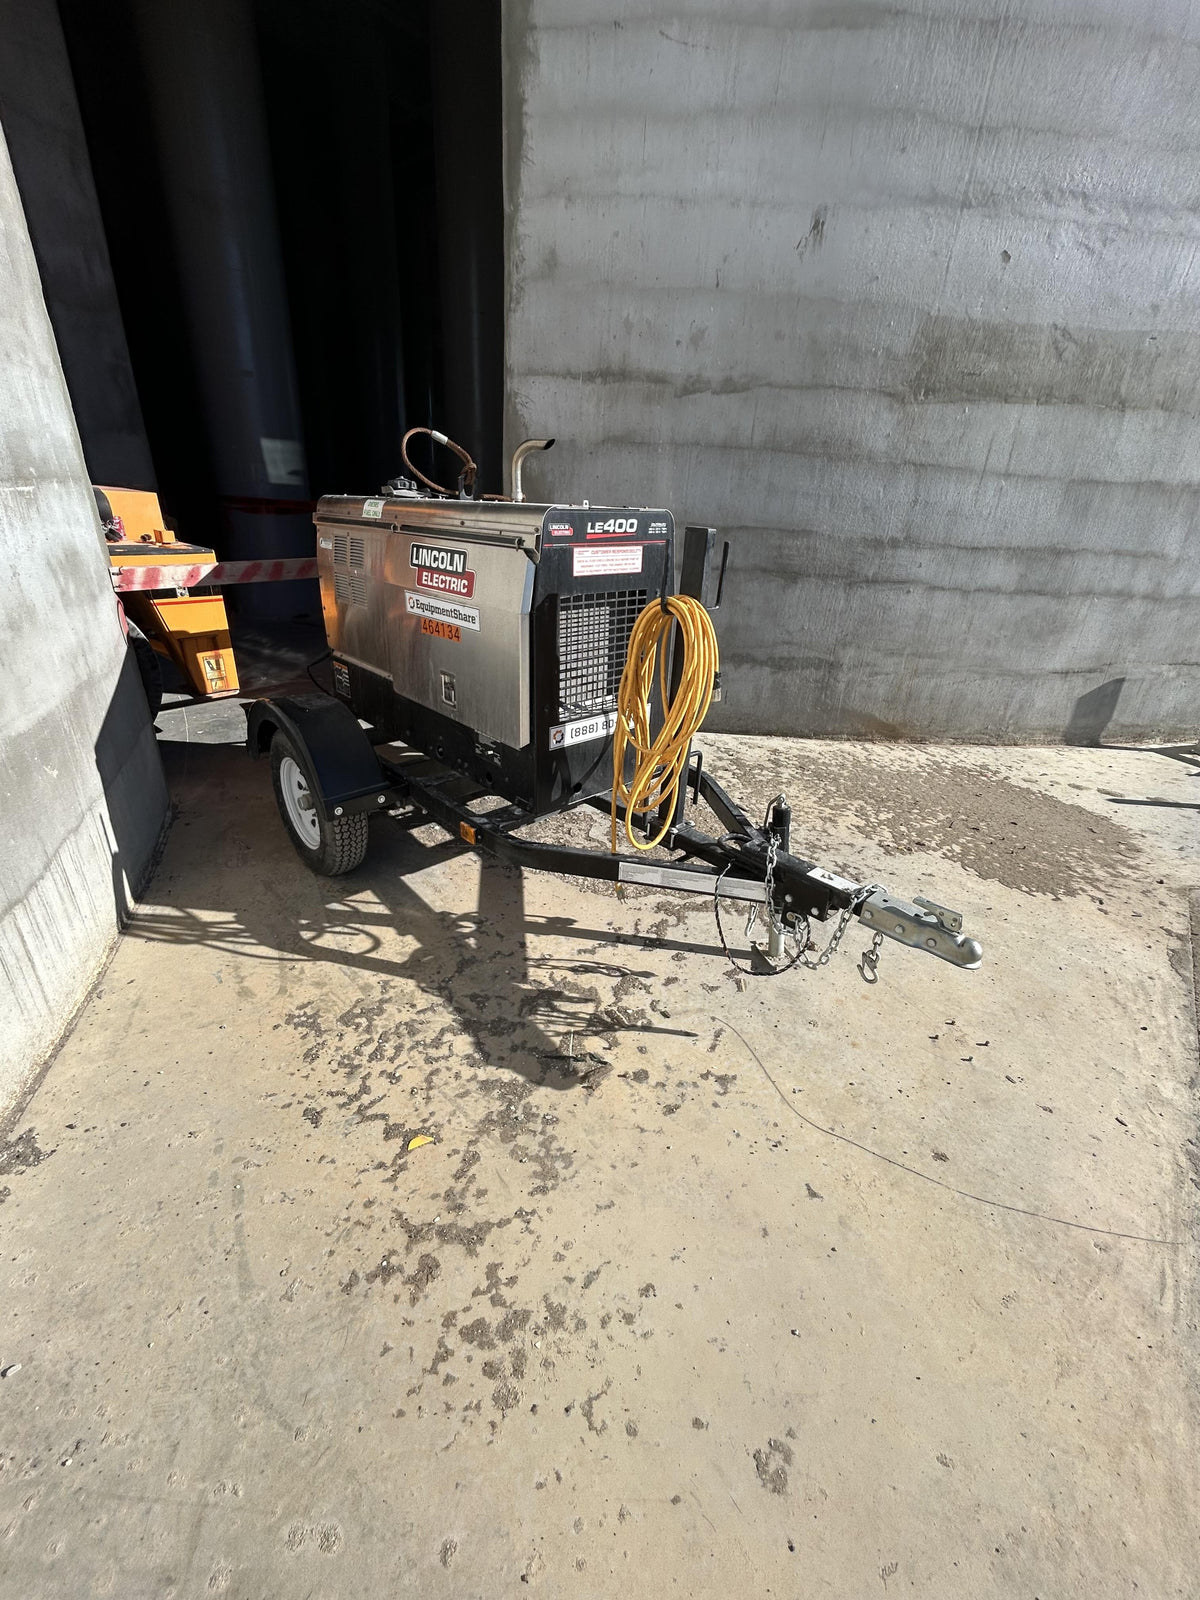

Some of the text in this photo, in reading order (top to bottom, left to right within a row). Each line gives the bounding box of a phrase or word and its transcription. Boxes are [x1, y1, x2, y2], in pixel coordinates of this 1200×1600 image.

[586, 518, 638, 534] LE400
[412, 547, 464, 573] LINCOLN
[421, 571, 469, 594] ELECTRIC
[415, 598, 476, 625] EquipmentShare
[422, 619, 460, 641] 464134
[570, 722, 599, 739] (888)
